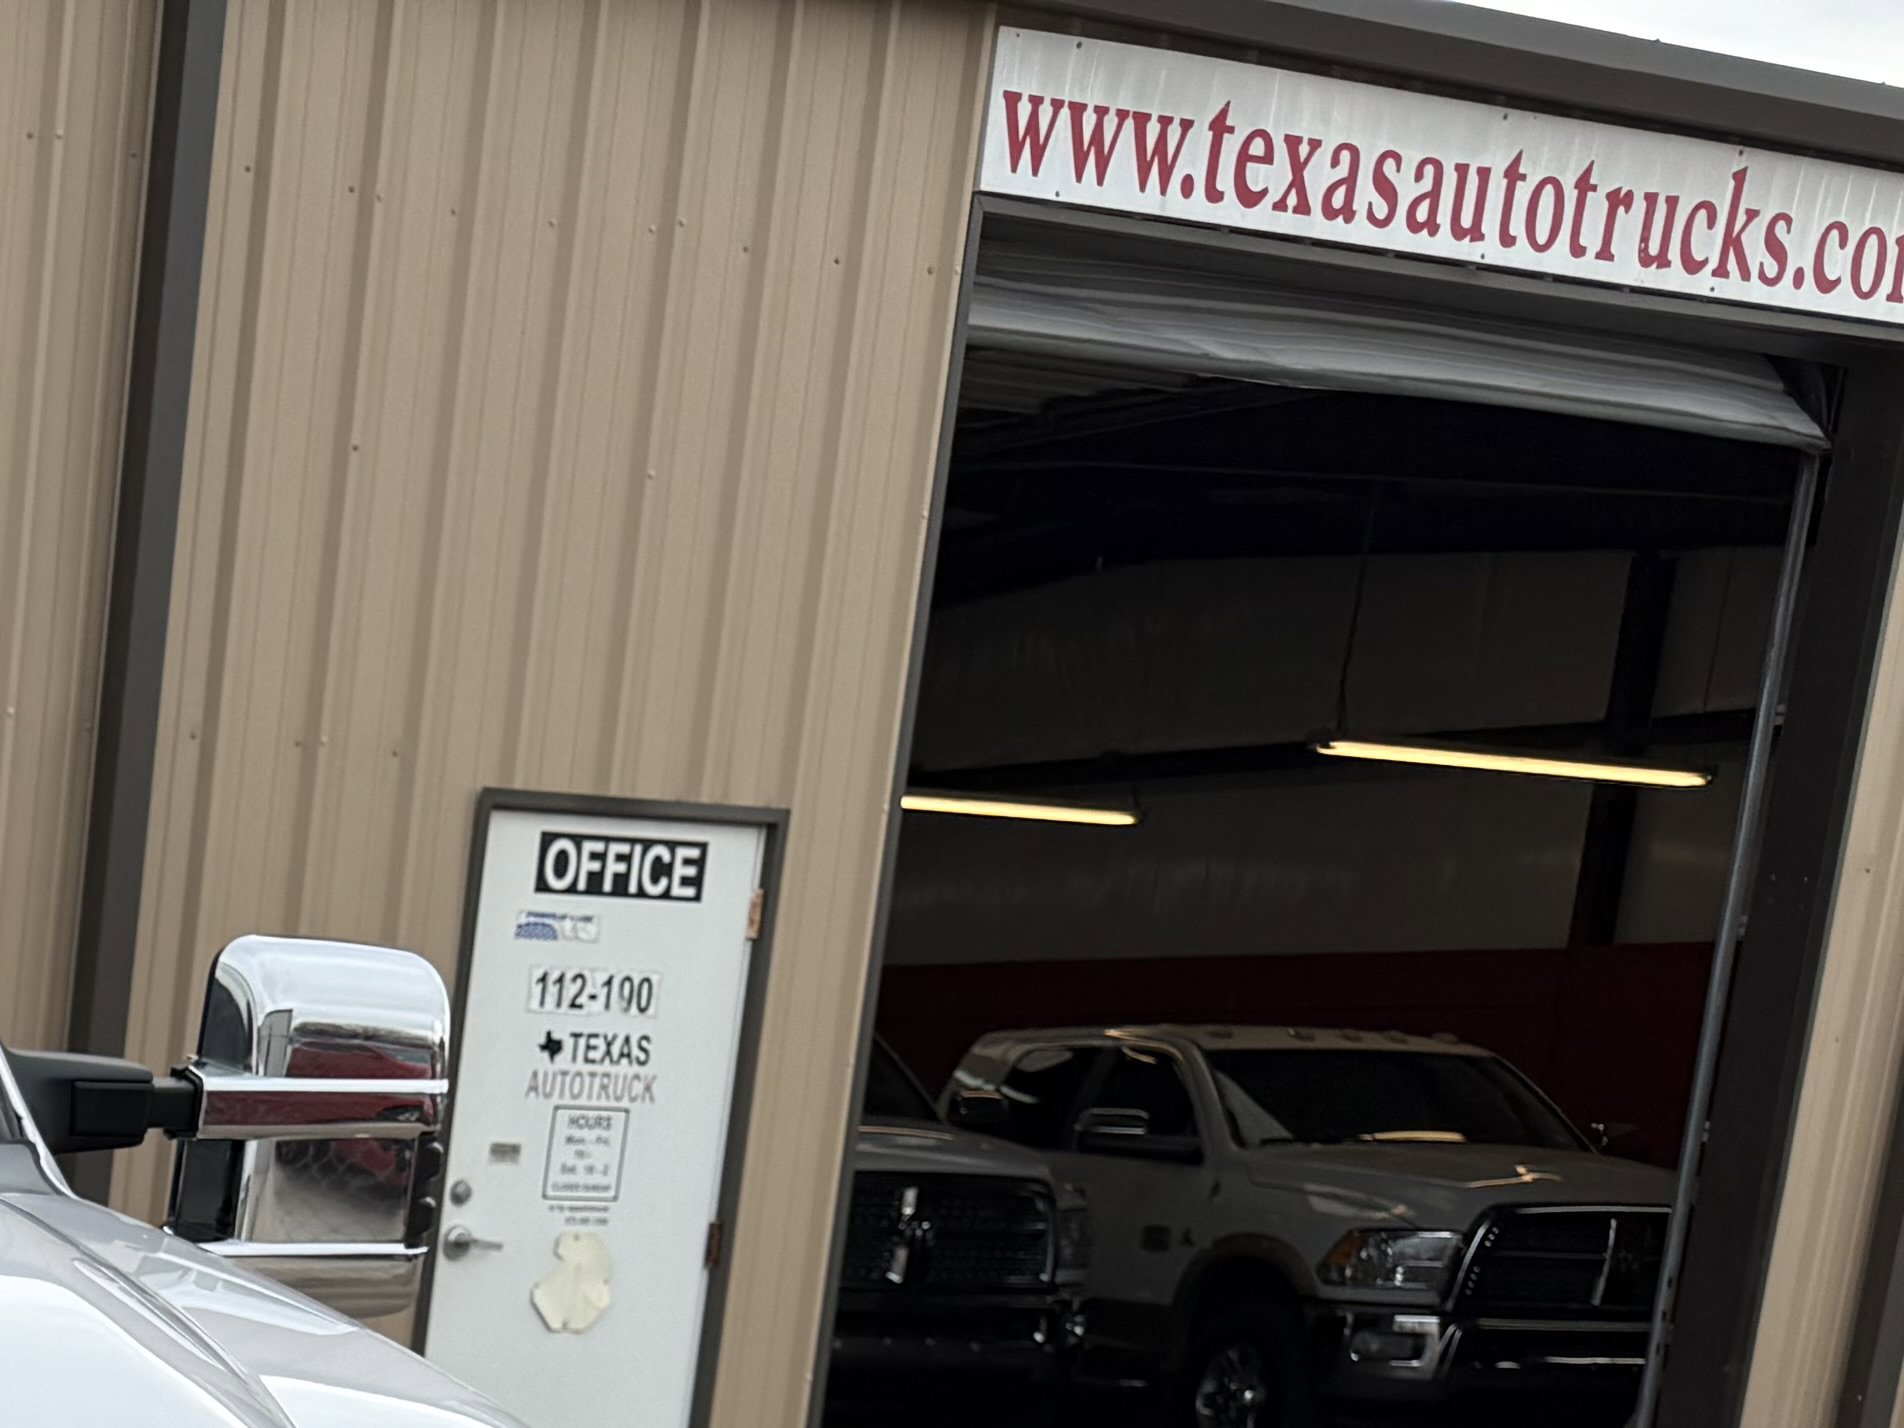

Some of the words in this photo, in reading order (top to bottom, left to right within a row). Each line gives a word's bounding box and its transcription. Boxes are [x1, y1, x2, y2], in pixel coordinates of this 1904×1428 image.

[544, 837, 701, 898] OFFICE
[535, 971, 654, 1015] 112-190
[569, 1032, 652, 1067] TEXAS
[525, 1069, 657, 1104] AUTOTRUCK
